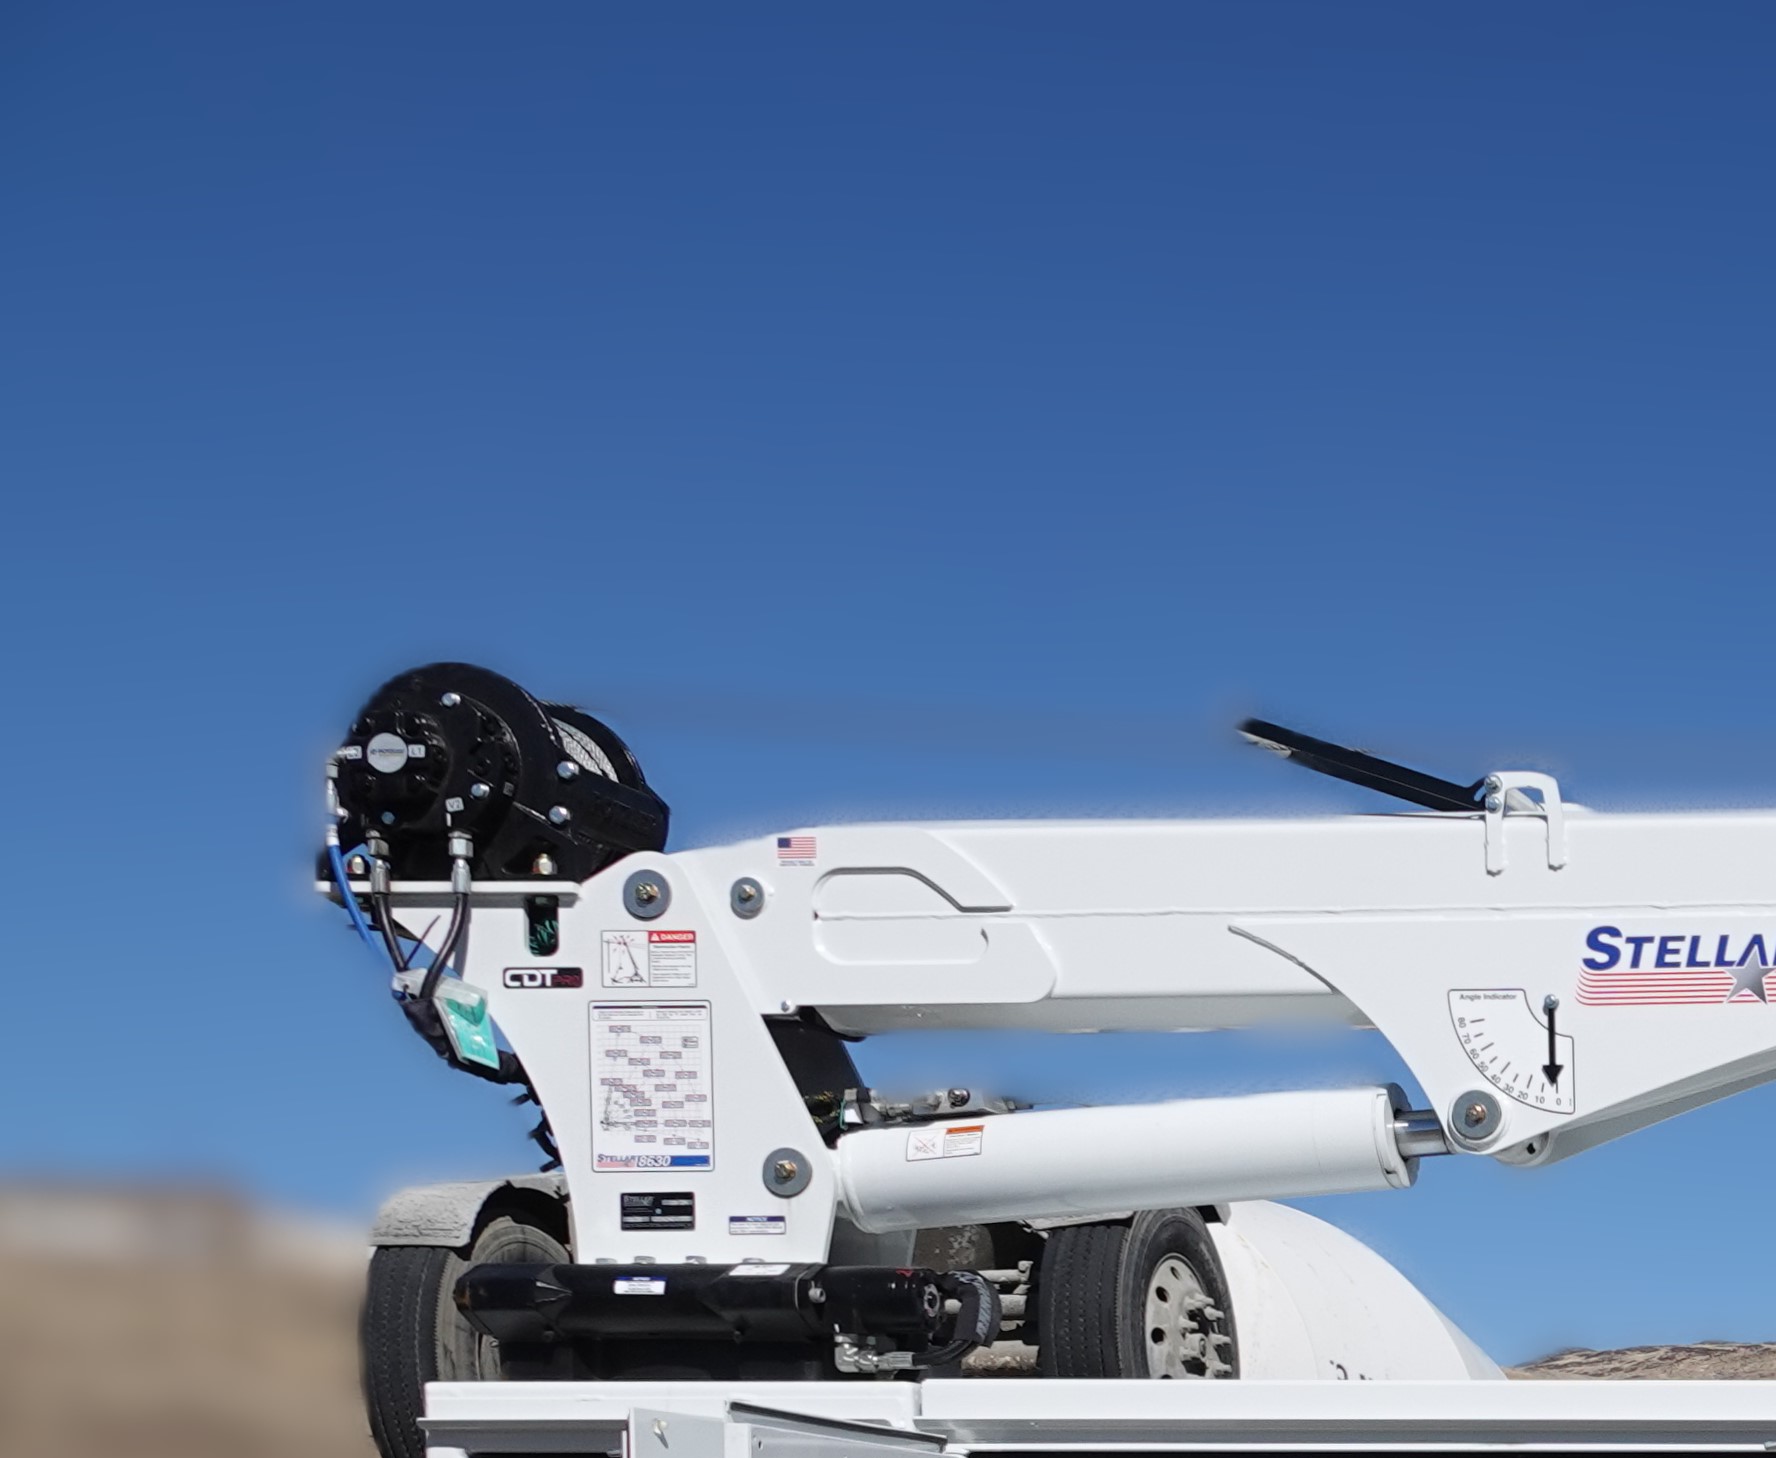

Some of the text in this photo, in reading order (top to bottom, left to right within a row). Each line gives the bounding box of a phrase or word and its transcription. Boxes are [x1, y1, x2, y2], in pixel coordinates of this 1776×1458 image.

[660, 933, 695, 941] DANGER
[504, 969, 557, 987] CDT
[1459, 994, 1482, 1002] Angle
[1457, 1017, 1467, 1029] 80
[1462, 1033, 1472, 1045] 70
[1469, 1048, 1480, 1060] 60
[1478, 1061, 1489, 1073] 50
[1490, 1073, 1502, 1084] 40
[1503, 1083, 1515, 1094] 30
[1517, 1090, 1529, 1101] 20
[1535, 1095, 1545, 1105] 10
[1555, 1097, 1562, 1106] 0
